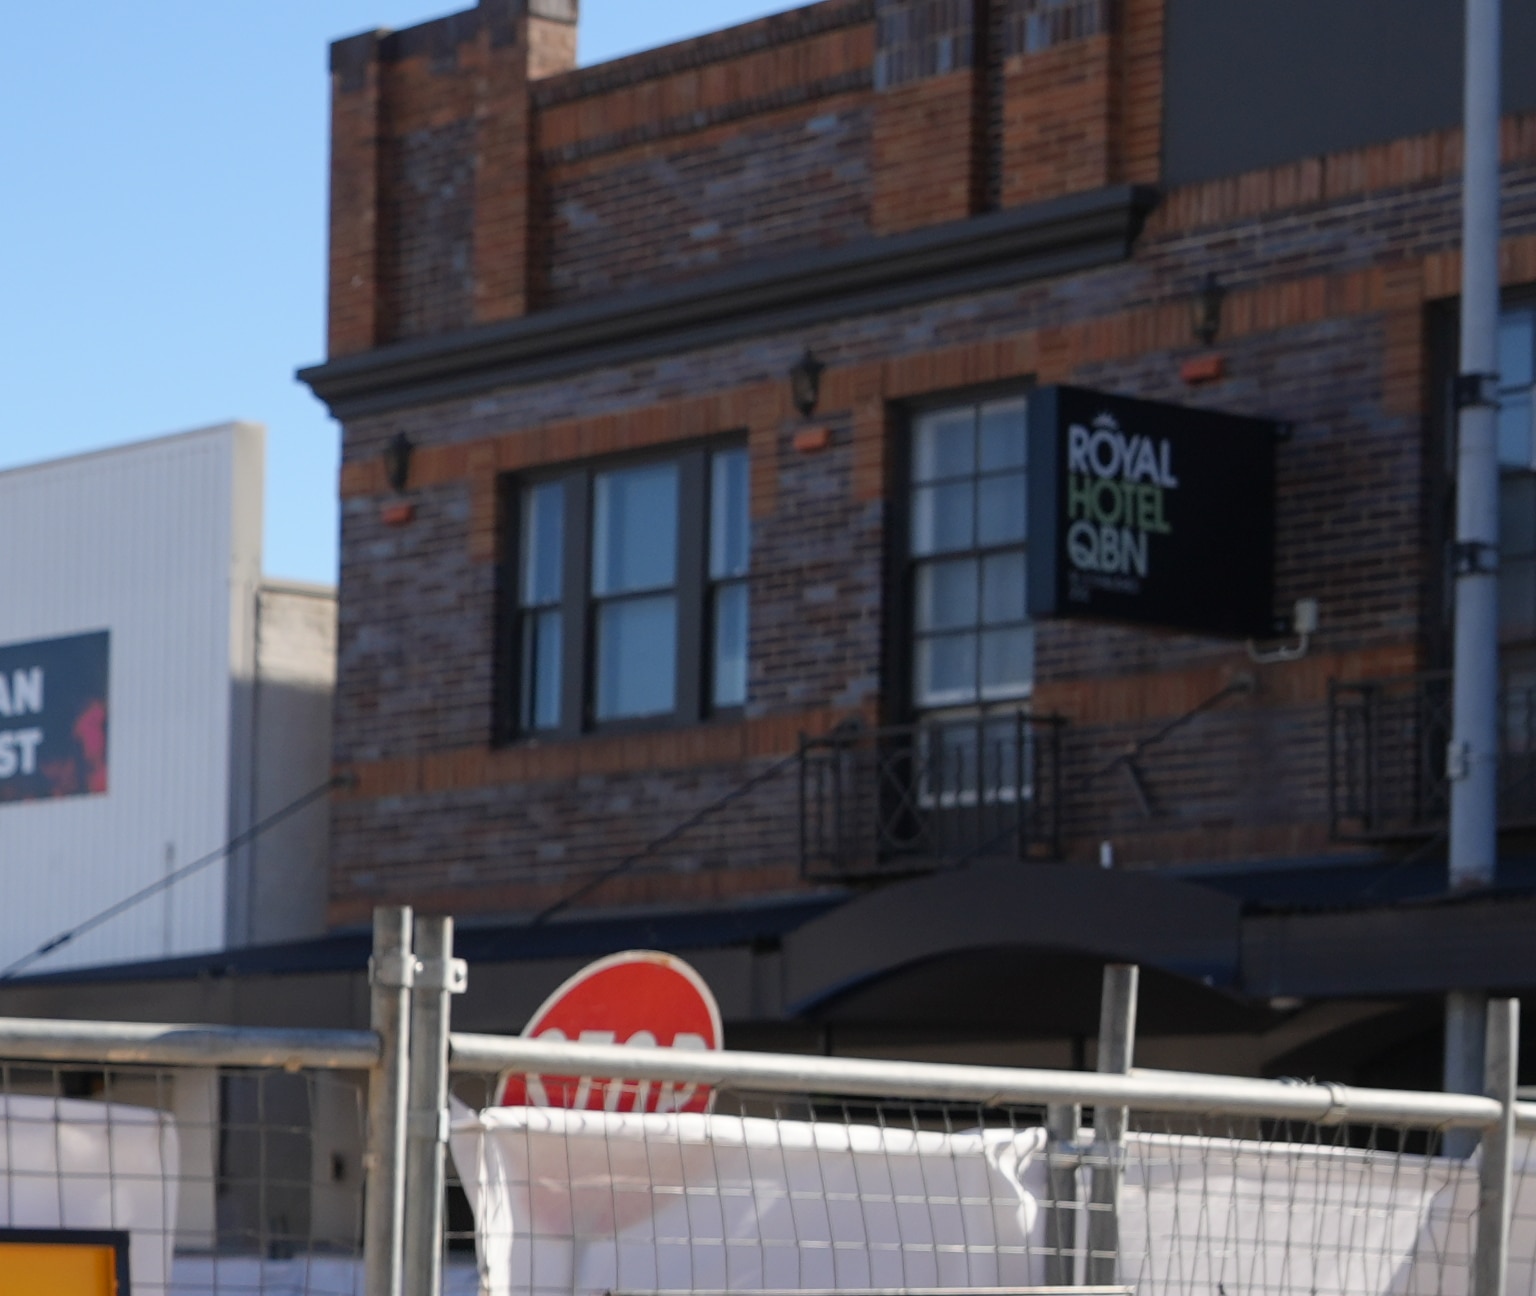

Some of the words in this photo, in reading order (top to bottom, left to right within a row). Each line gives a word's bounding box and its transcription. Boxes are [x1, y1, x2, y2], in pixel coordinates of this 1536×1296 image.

[1068, 423, 1179, 488] ROYAL
[1067, 473, 1171, 534] HOTEL
[1067, 520, 1148, 578] QBN
